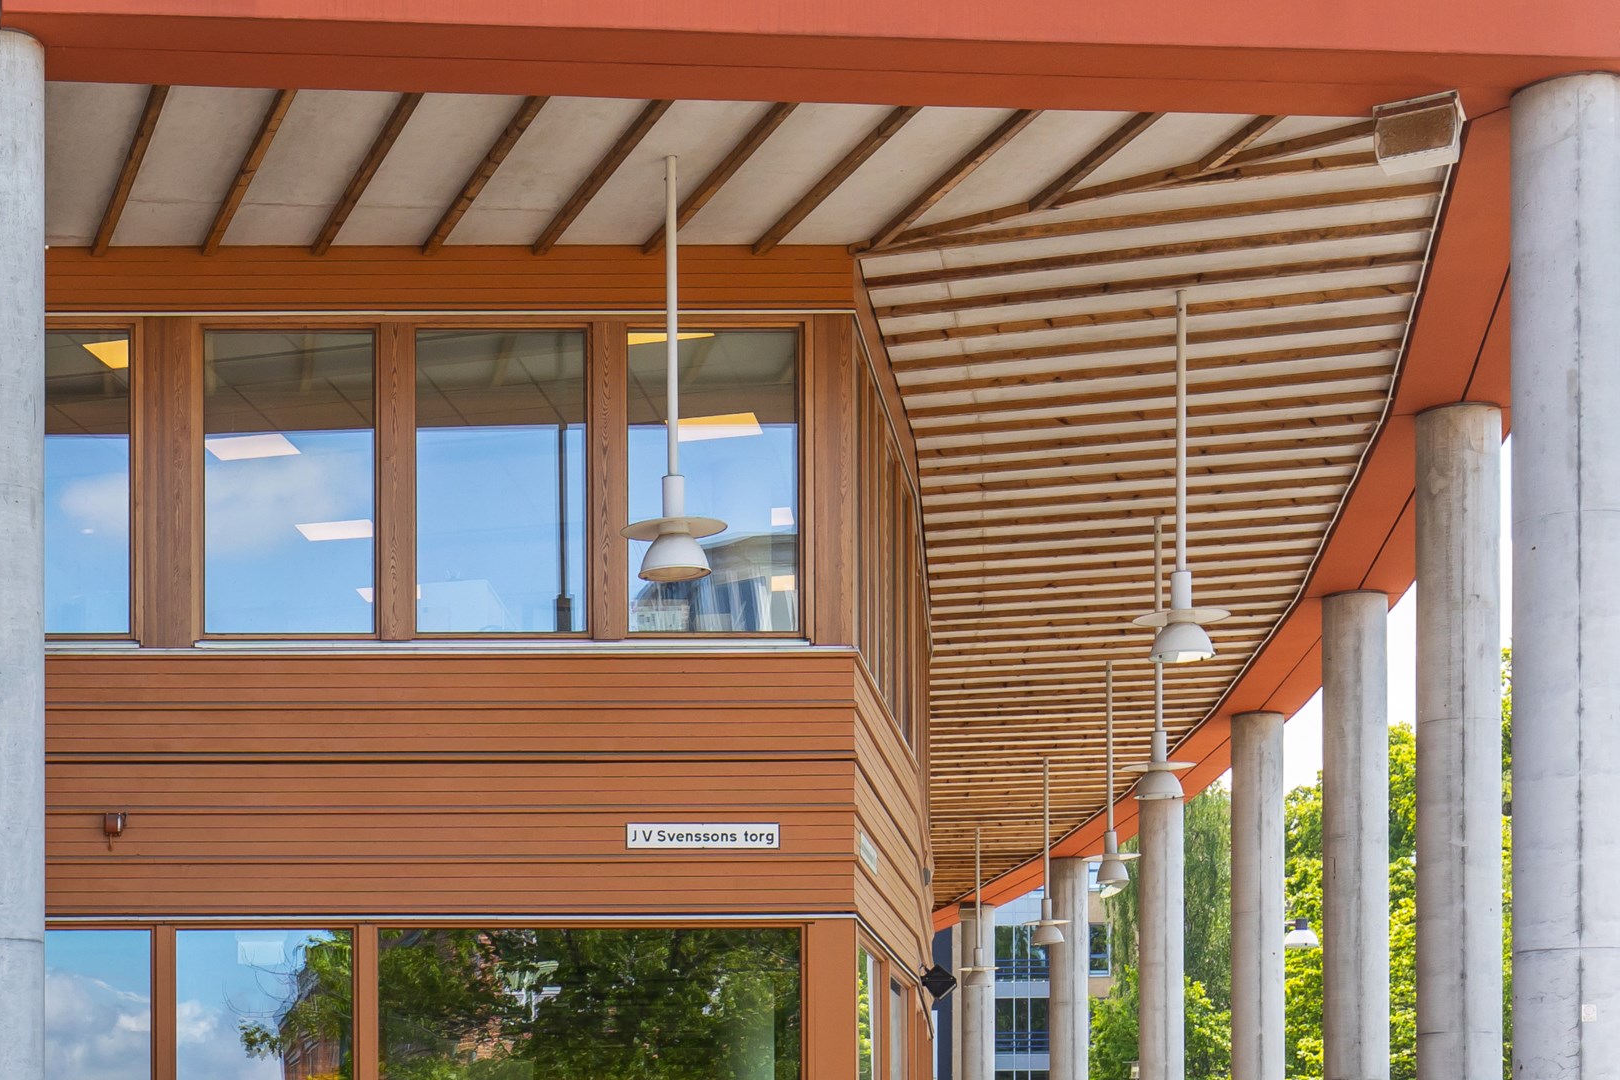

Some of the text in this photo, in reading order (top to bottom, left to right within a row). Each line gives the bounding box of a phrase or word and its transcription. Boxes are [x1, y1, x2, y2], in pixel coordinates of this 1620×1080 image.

[631, 830, 775, 845] J V Svenssons torg
